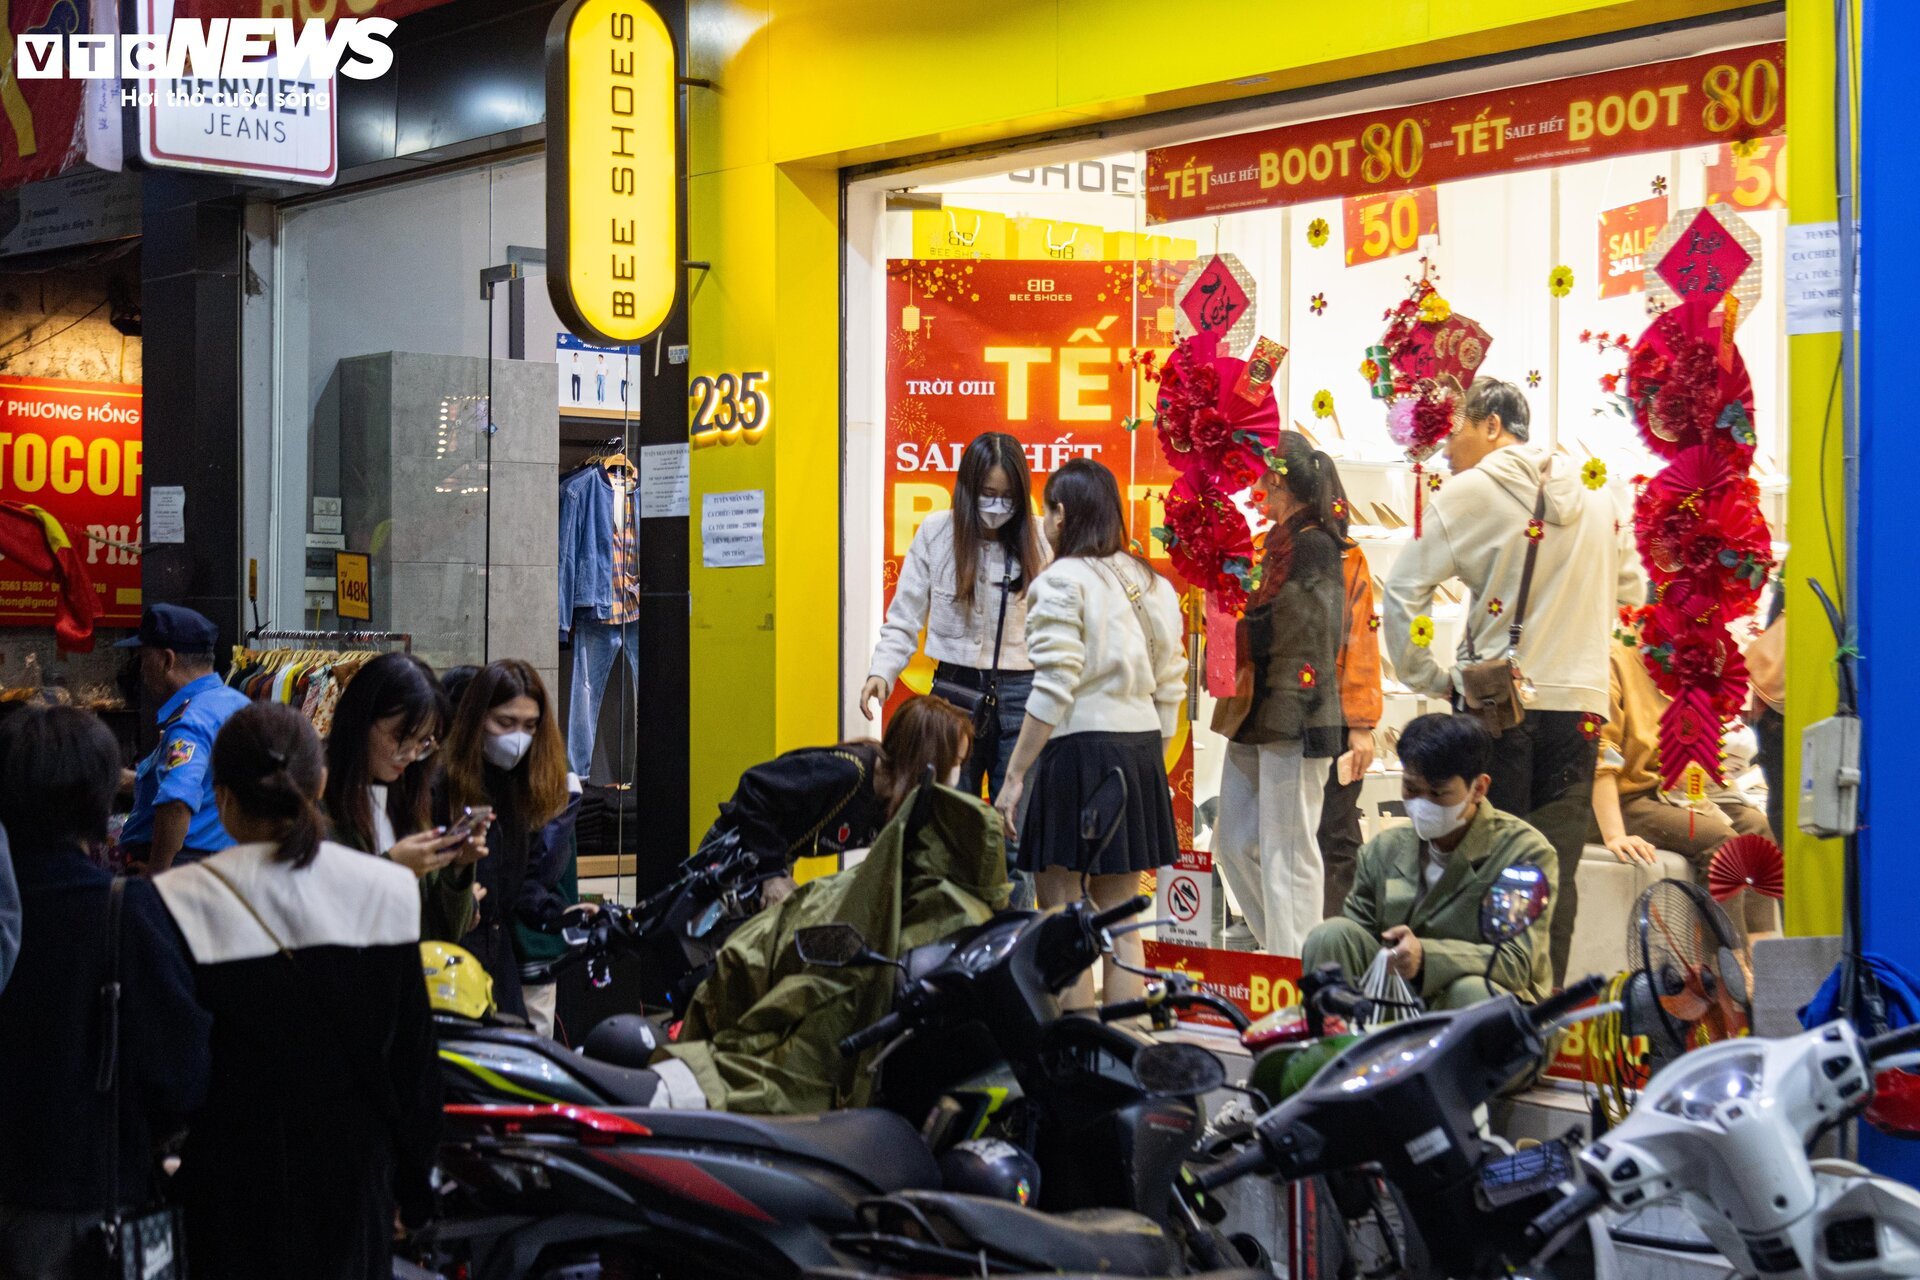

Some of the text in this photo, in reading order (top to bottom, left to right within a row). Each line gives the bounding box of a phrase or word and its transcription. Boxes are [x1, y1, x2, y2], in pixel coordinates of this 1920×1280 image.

[1452, 107, 1510, 156] TẾT
[1504, 121, 1536, 141] SALE
[1538, 115, 1565, 135] HẾT
[1568, 84, 1688, 142] BOOT
[1702, 58, 1779, 133] 80
[204, 113, 286, 143] JEANS
[611, 12, 636, 319] BEE SHOES
[1164, 155, 1213, 199] TẾT
[1210, 171, 1237, 187] SALE
[1239, 164, 1262, 181] HẾT
[1259, 139, 1356, 190] BOOT
[1363, 196, 1419, 257] 50
[1034, 294, 1072, 302] SHOES
[906, 377, 954, 396] TRỜI
[958, 380, 996, 396] ƠIII
[8, 401, 83, 421] PHƯƠNG
[87, 402, 141, 424] HỒNG
[689, 371, 768, 436] 235
[340, 579, 369, 604] 148K
[1228, 982, 1251, 1001] HẾT
